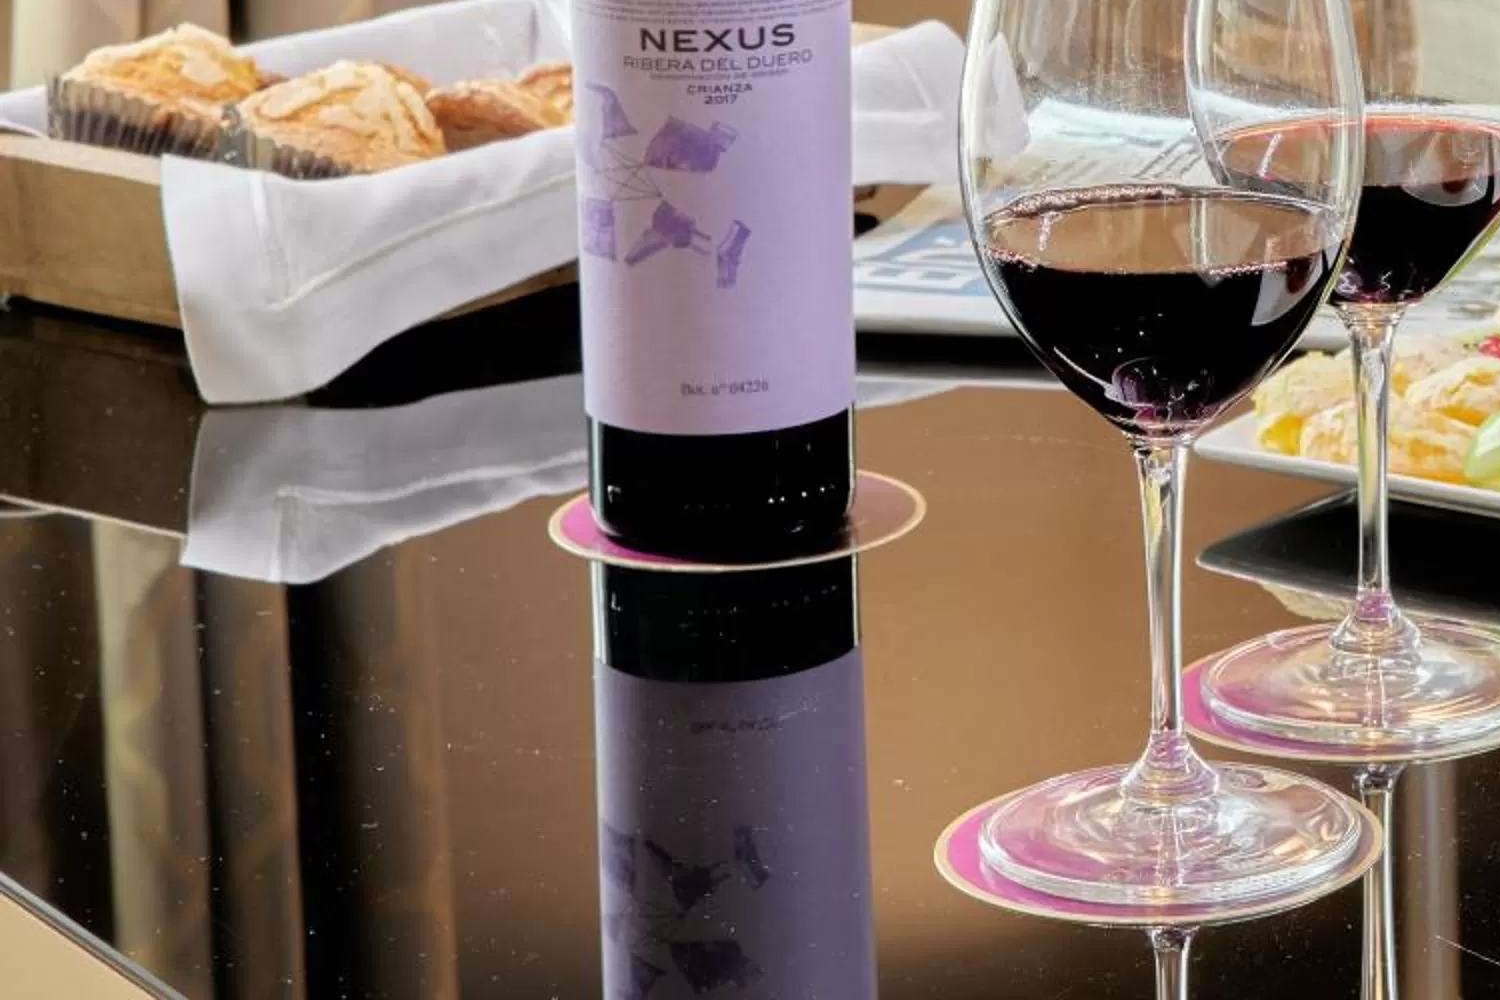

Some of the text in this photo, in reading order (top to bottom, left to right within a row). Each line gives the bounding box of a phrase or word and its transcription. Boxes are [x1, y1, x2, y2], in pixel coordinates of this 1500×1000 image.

[639, 23, 796, 53] NEXUS
[623, 49, 813, 72] RIBERA DEL DUERO
[686, 83, 753, 96] CRIANZA
[704, 94, 739, 105] 2017
